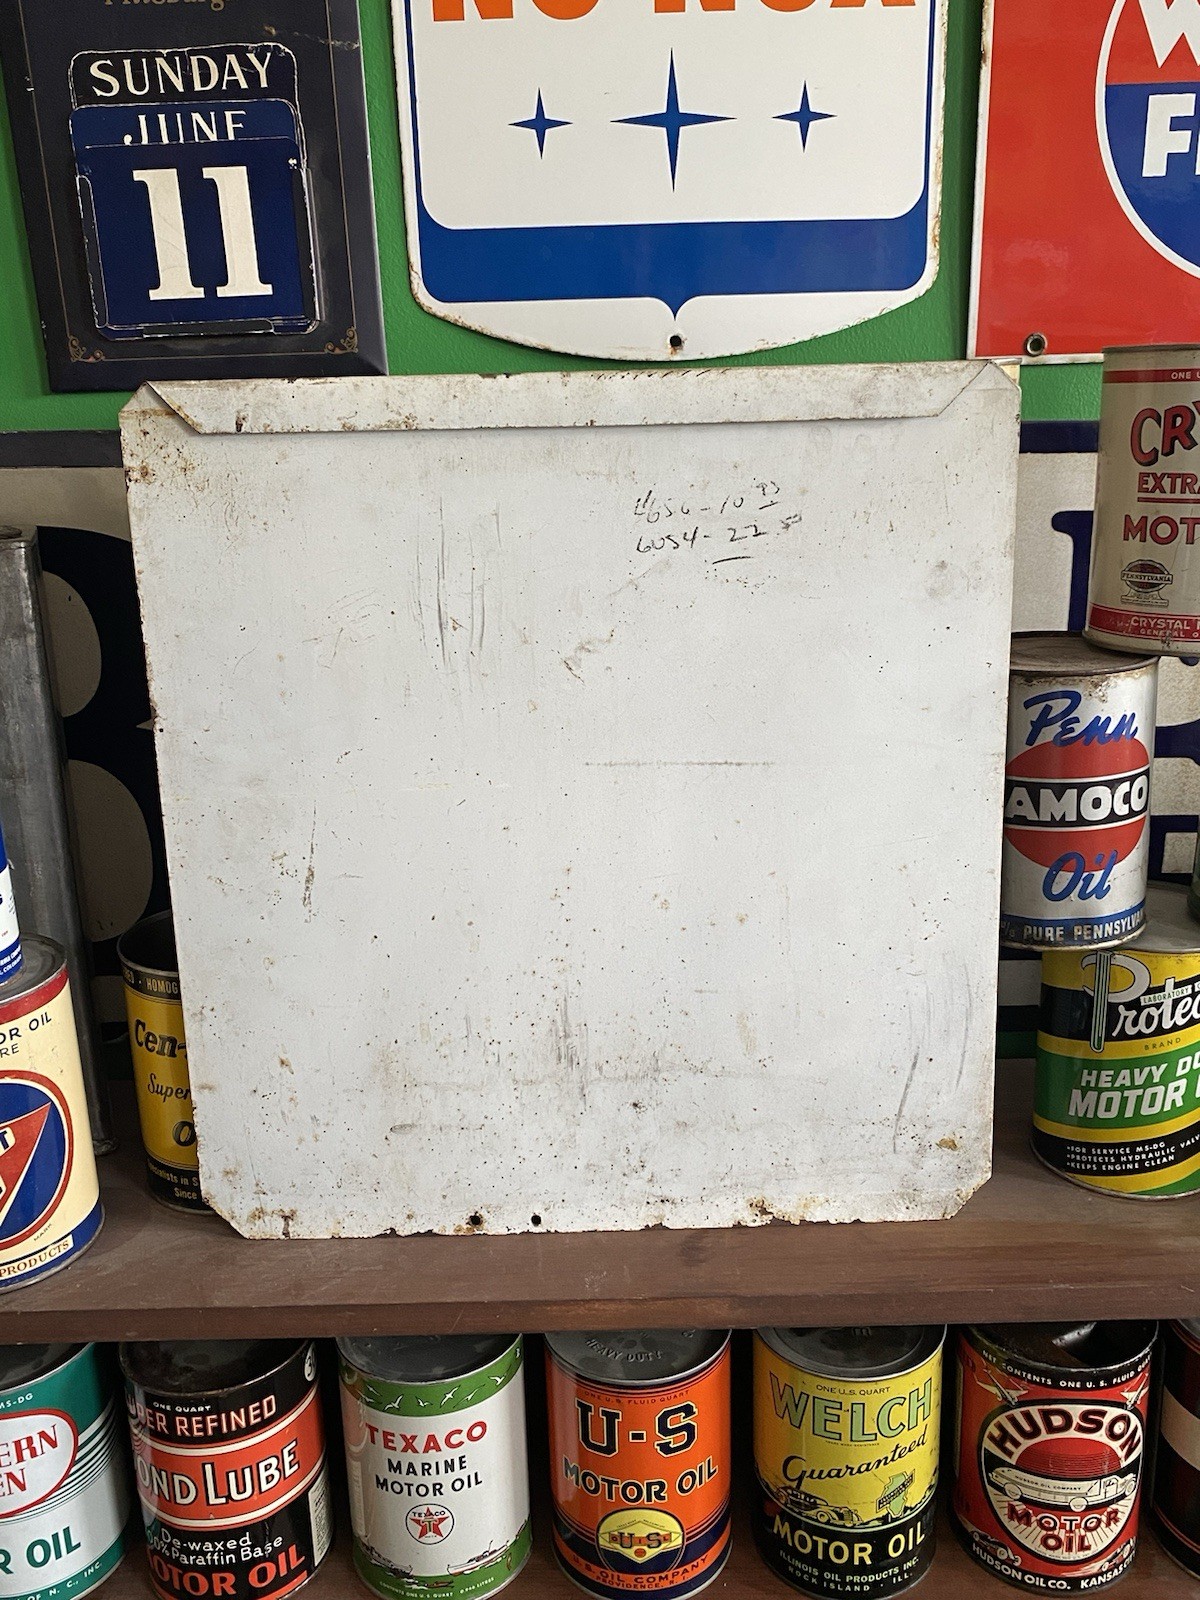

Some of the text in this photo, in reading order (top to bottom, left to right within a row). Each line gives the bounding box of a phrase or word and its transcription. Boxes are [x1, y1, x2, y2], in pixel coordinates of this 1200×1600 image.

[89, 52, 272, 98] SUNDAY
[1142, 93, 1200, 177] F
[133, 165, 273, 301] 11
[1170, 371, 1192, 380] ONE
[1138, 472, 1200, 494] EXTR
[1130, 616, 1190, 630] CRYSTAL
[1023, 690, 1139, 746] Penn
[1005, 774, 1149, 822] AMOCO
[1042, 850, 1119, 901] Oil
[1023, 924, 1065, 942] PURE
[1143, 987, 1190, 1004] LABORATORY
[28, 1012, 52, 1031] OIL
[1144, 1037, 1182, 1051] BRAND
[1081, 1063, 1168, 1087] HEAVY
[1068, 1078, 1187, 1119] MOTOR
[1071, 1153, 1116, 1163] PROTECTS
[1120, 1145, 1176, 1162] HYDRAULIC
[1071, 1154, 1175, 1171] KEEPS ENGINE CLEAN
[1091, 1146, 1131, 1155] SERVICE
[1136, 1141, 1166, 1153] MS-DG
[174, 1187, 198, 1200] Since
[0, 1240, 69, 1278] PRODUCTS
[585, 1338, 622, 1360] HEAVY
[816, 1384, 836, 1395] ONE
[859, 1386, 892, 1396] QUART
[1001, 1362, 1052, 1386] CONTENTS
[1059, 1380, 1082, 1388] ONE
[1112, 1371, 1135, 1385] FLUID
[152, 1401, 212, 1413] ONE QUART
[659, 1389, 690, 1403] QUART
[769, 1370, 933, 1442] WELCH
[175, 1394, 277, 1437] REFINED
[365, 1421, 487, 1454] TEXACO
[985, 1408, 1141, 1461] HUDSON
[202, 1437, 300, 1507] LUBE
[387, 1454, 468, 1477] MARINE
[782, 1423, 929, 1491] Guaranteed
[375, 1472, 483, 1498] MOTOR OIL
[563, 1455, 719, 1504] MOTOR OIL
[1006, 1501, 1121, 1533] MOTOR
[26, 1526, 81, 1568] OIL
[161, 1527, 252, 1553] De-waxed
[171, 1545, 236, 1566] Paraffin
[240, 1535, 283, 1562] Base
[773, 1514, 925, 1566] MOTOR OIL
[1040, 1532, 1092, 1553] OIL
[248, 1543, 306, 1589] OIL
[600, 1570, 627, 1584] OIL
[633, 1554, 708, 1585] COMPANY
[780, 1549, 819, 1576] ILLINOIS
[823, 1571, 842, 1582] OIL
[845, 1566, 899, 1583] PRODUCTS
[788, 1565, 818, 1585] ROCK
[823, 1581, 870, 1592] ISLAND
[972, 1542, 1022, 1581] HUDSON
[1024, 1573, 1047, 1588] OIL
[1047, 1579, 1072, 1590] CO.
[1080, 1564, 1124, 1590] KANSAS
